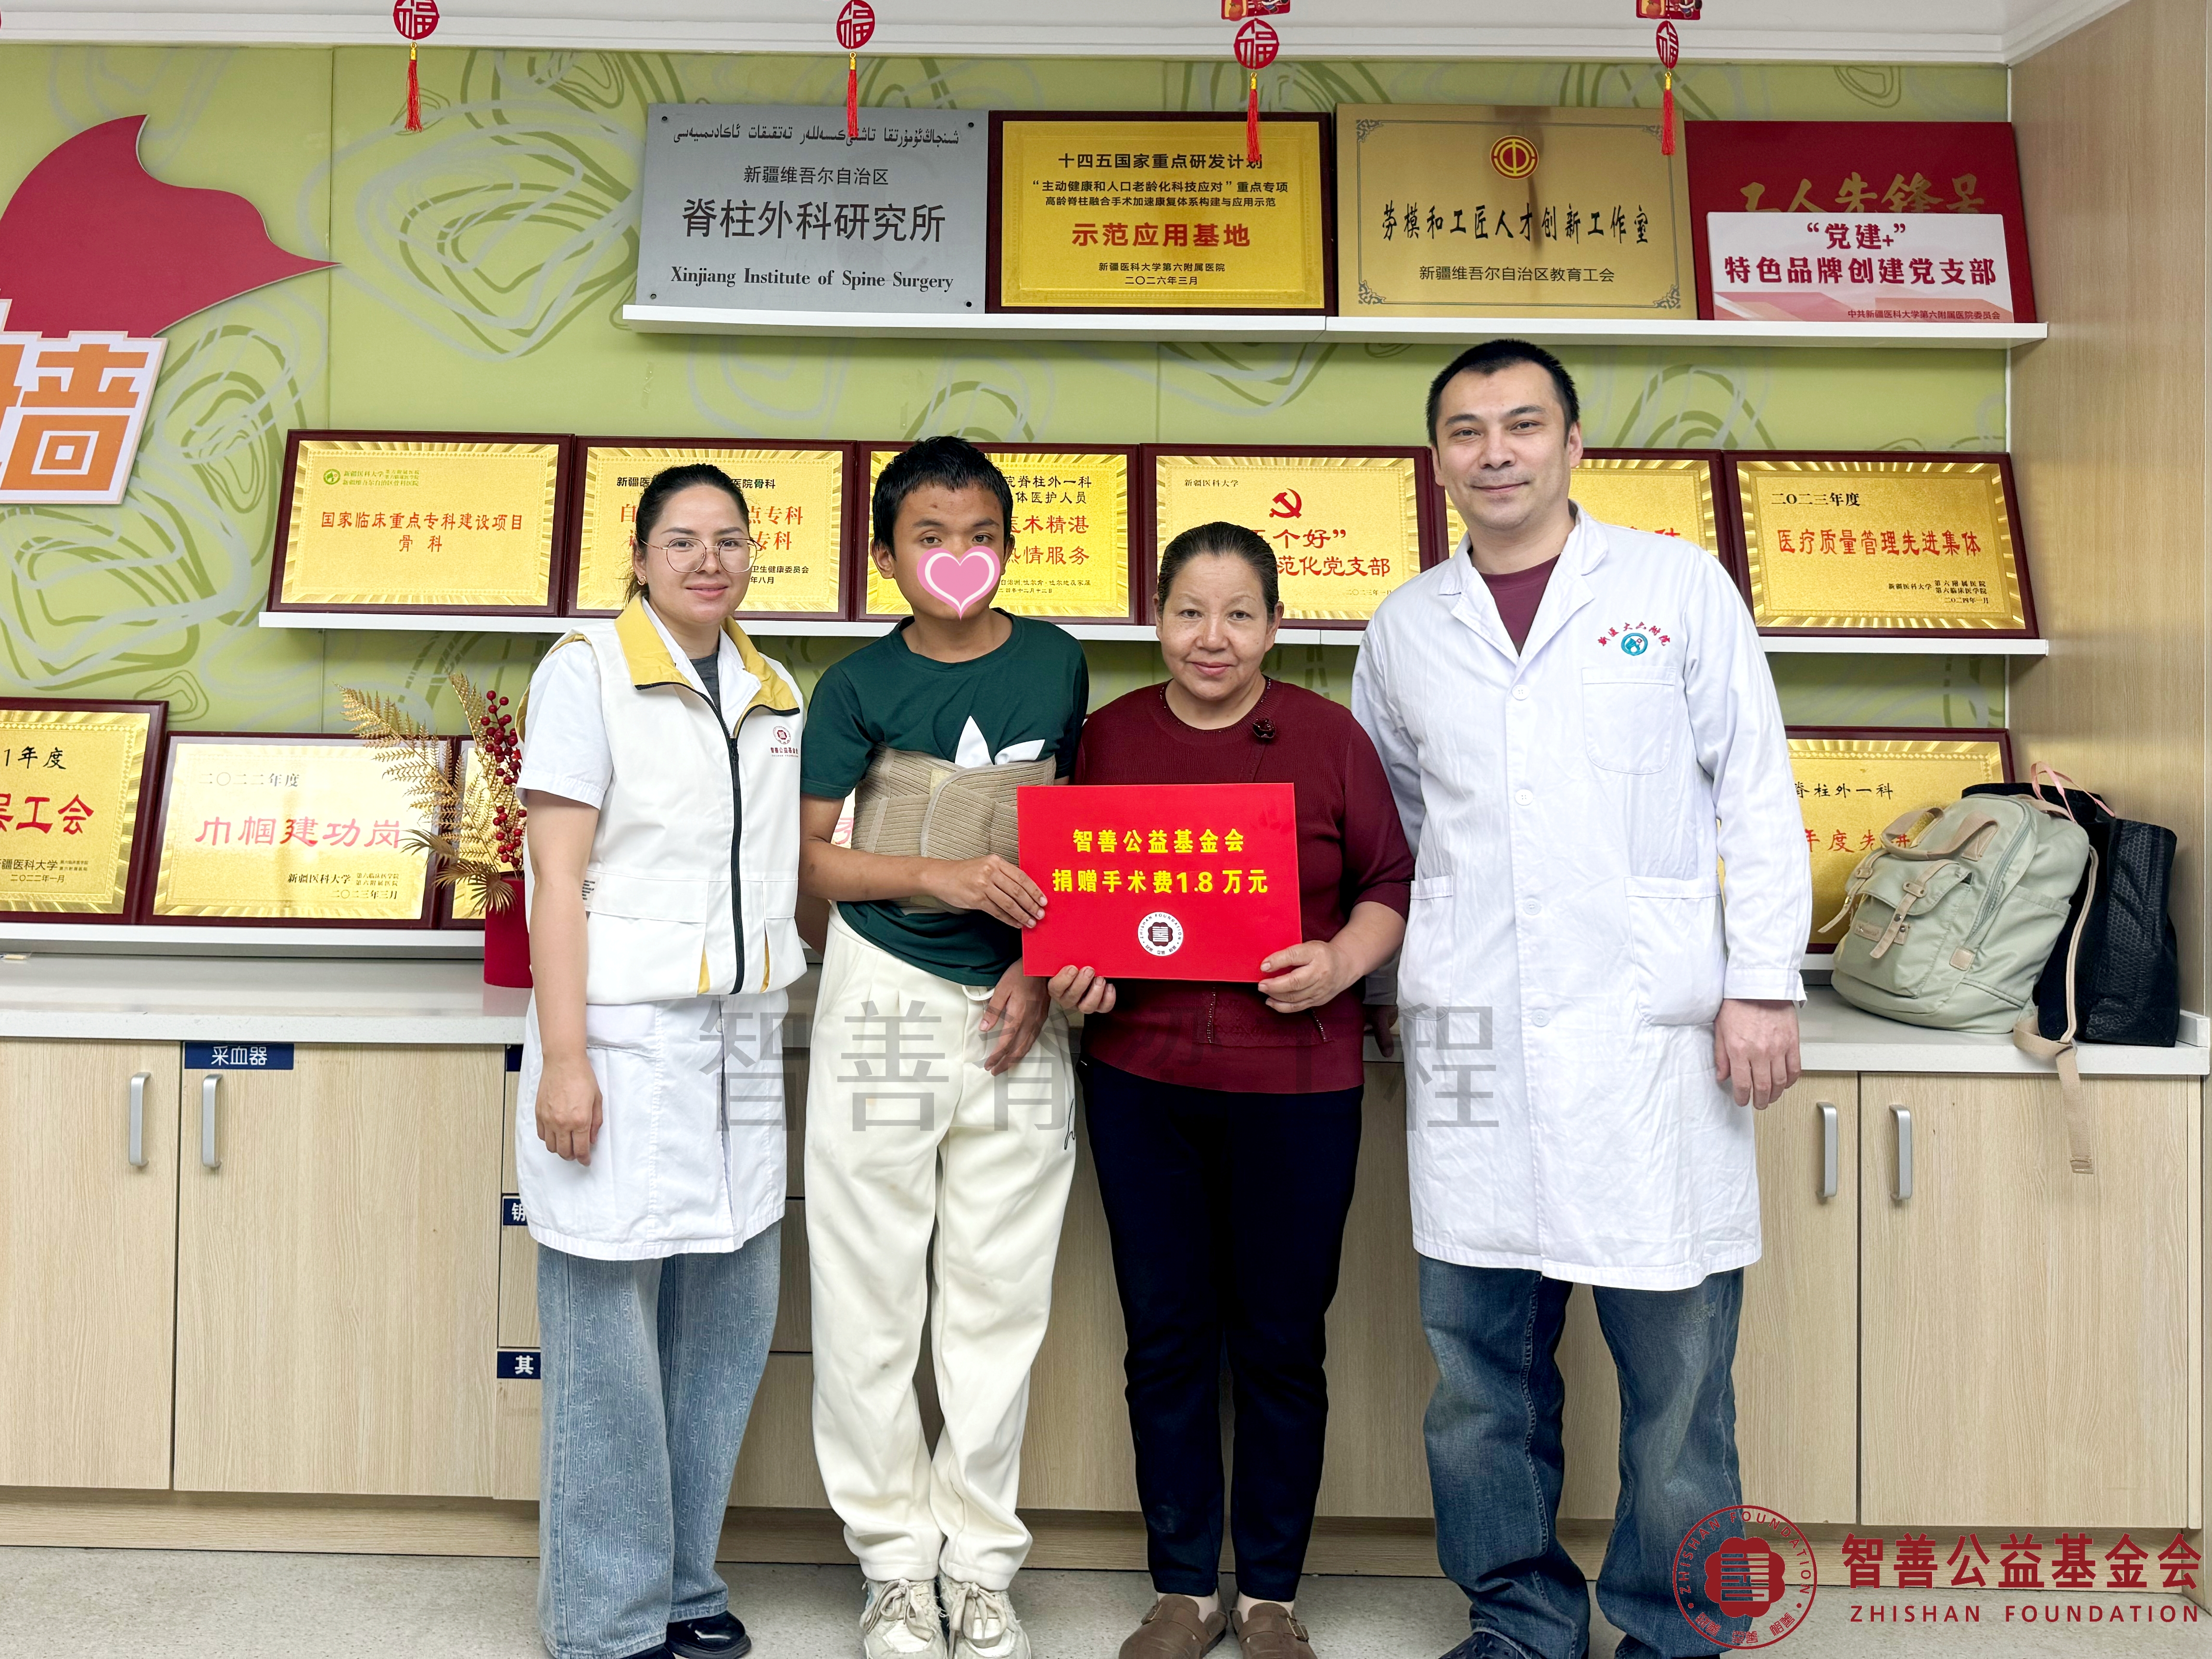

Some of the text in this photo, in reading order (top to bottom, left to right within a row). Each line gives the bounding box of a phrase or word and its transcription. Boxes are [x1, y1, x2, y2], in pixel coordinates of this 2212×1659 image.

[397, 0, 436, 38] 福
[838, 1, 873, 47] 福
[1238, 21, 1277, 67] 福
[1657, 23, 1678, 68] 福
[1058, 153, 1263, 170] 十四五国家重点研发计划
[744, 165, 889, 186] 新疆维吾尔自治区
[1045, 197, 1276, 207] 高龄脊柱融合手术加速康复体系构建与应用示范
[683, 198, 946, 242] 脊柱外科研究所
[1382, 200, 1649, 244] 劳模和工匠人才创新工作室
[1072, 222, 1251, 247] 示范应用基地
[1807, 222, 1906, 250] “党建+”
[671, 266, 953, 292] Xinjiang Institute of Spine Surgery
[1098, 262, 1226, 272] 新疆医科大学第六附属医院
[1419, 266, 1615, 283] 新疆维吾尔自治区教育工会
[1724, 256, 1996, 286] 特色品牌创建党支部
[1847, 309, 2001, 320] 中共新疆医科大学第六附属医院委员会
[1015, 491, 1087, 504] 体医护人员
[321, 511, 523, 532] 国家临床重点专科建设项目
[1777, 528, 1982, 557] 医疗质量管理先进集体
[195, 816, 402, 848] 巾帼建功岗
[1073, 828, 1244, 853] 智善公益基金会
[0, 859, 58, 871] 疆医科大学
[288, 873, 351, 884] 新疆医科大学
[211, 1046, 268, 1066] 采血器
[514, 1355, 534, 1375] 其
